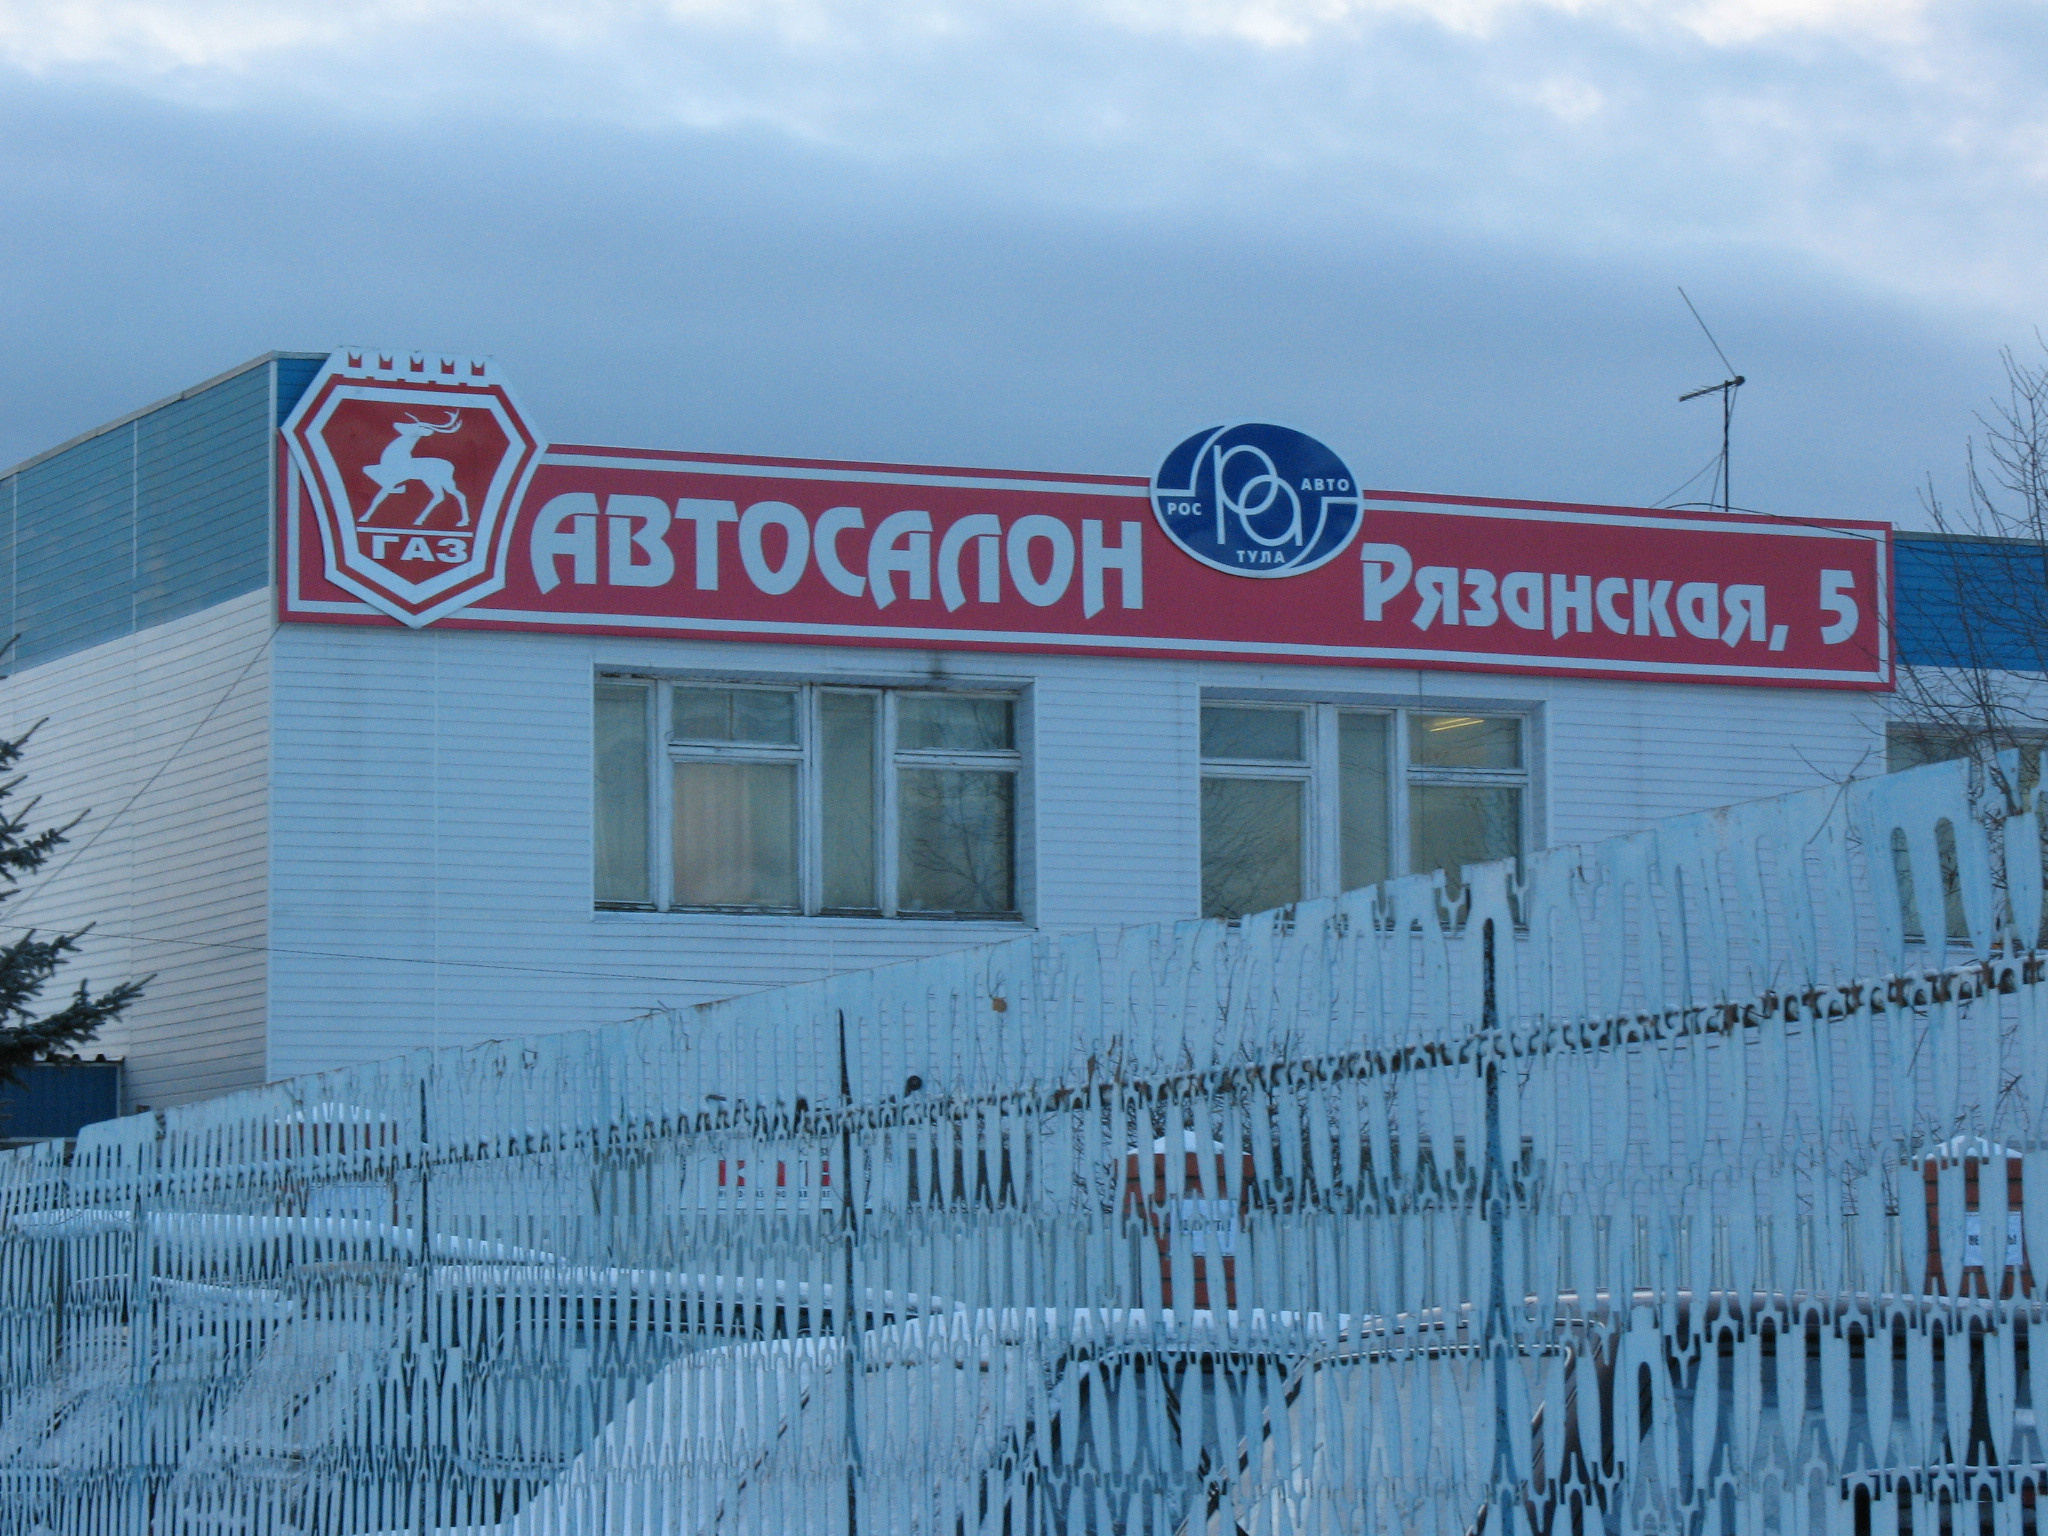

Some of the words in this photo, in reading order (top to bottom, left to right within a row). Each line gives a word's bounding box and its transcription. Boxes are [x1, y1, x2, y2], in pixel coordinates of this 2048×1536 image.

[1300, 477, 1350, 491] АВТО
[1166, 502, 1202, 516] РОС
[371, 535, 469, 563] ГАЗ
[529, 491, 1146, 620] АВТОСАЛОН
[1236, 550, 1286, 564] ТУЛА
[1360, 542, 1790, 652] Рязанская,
[1819, 569, 1860, 645] 5
